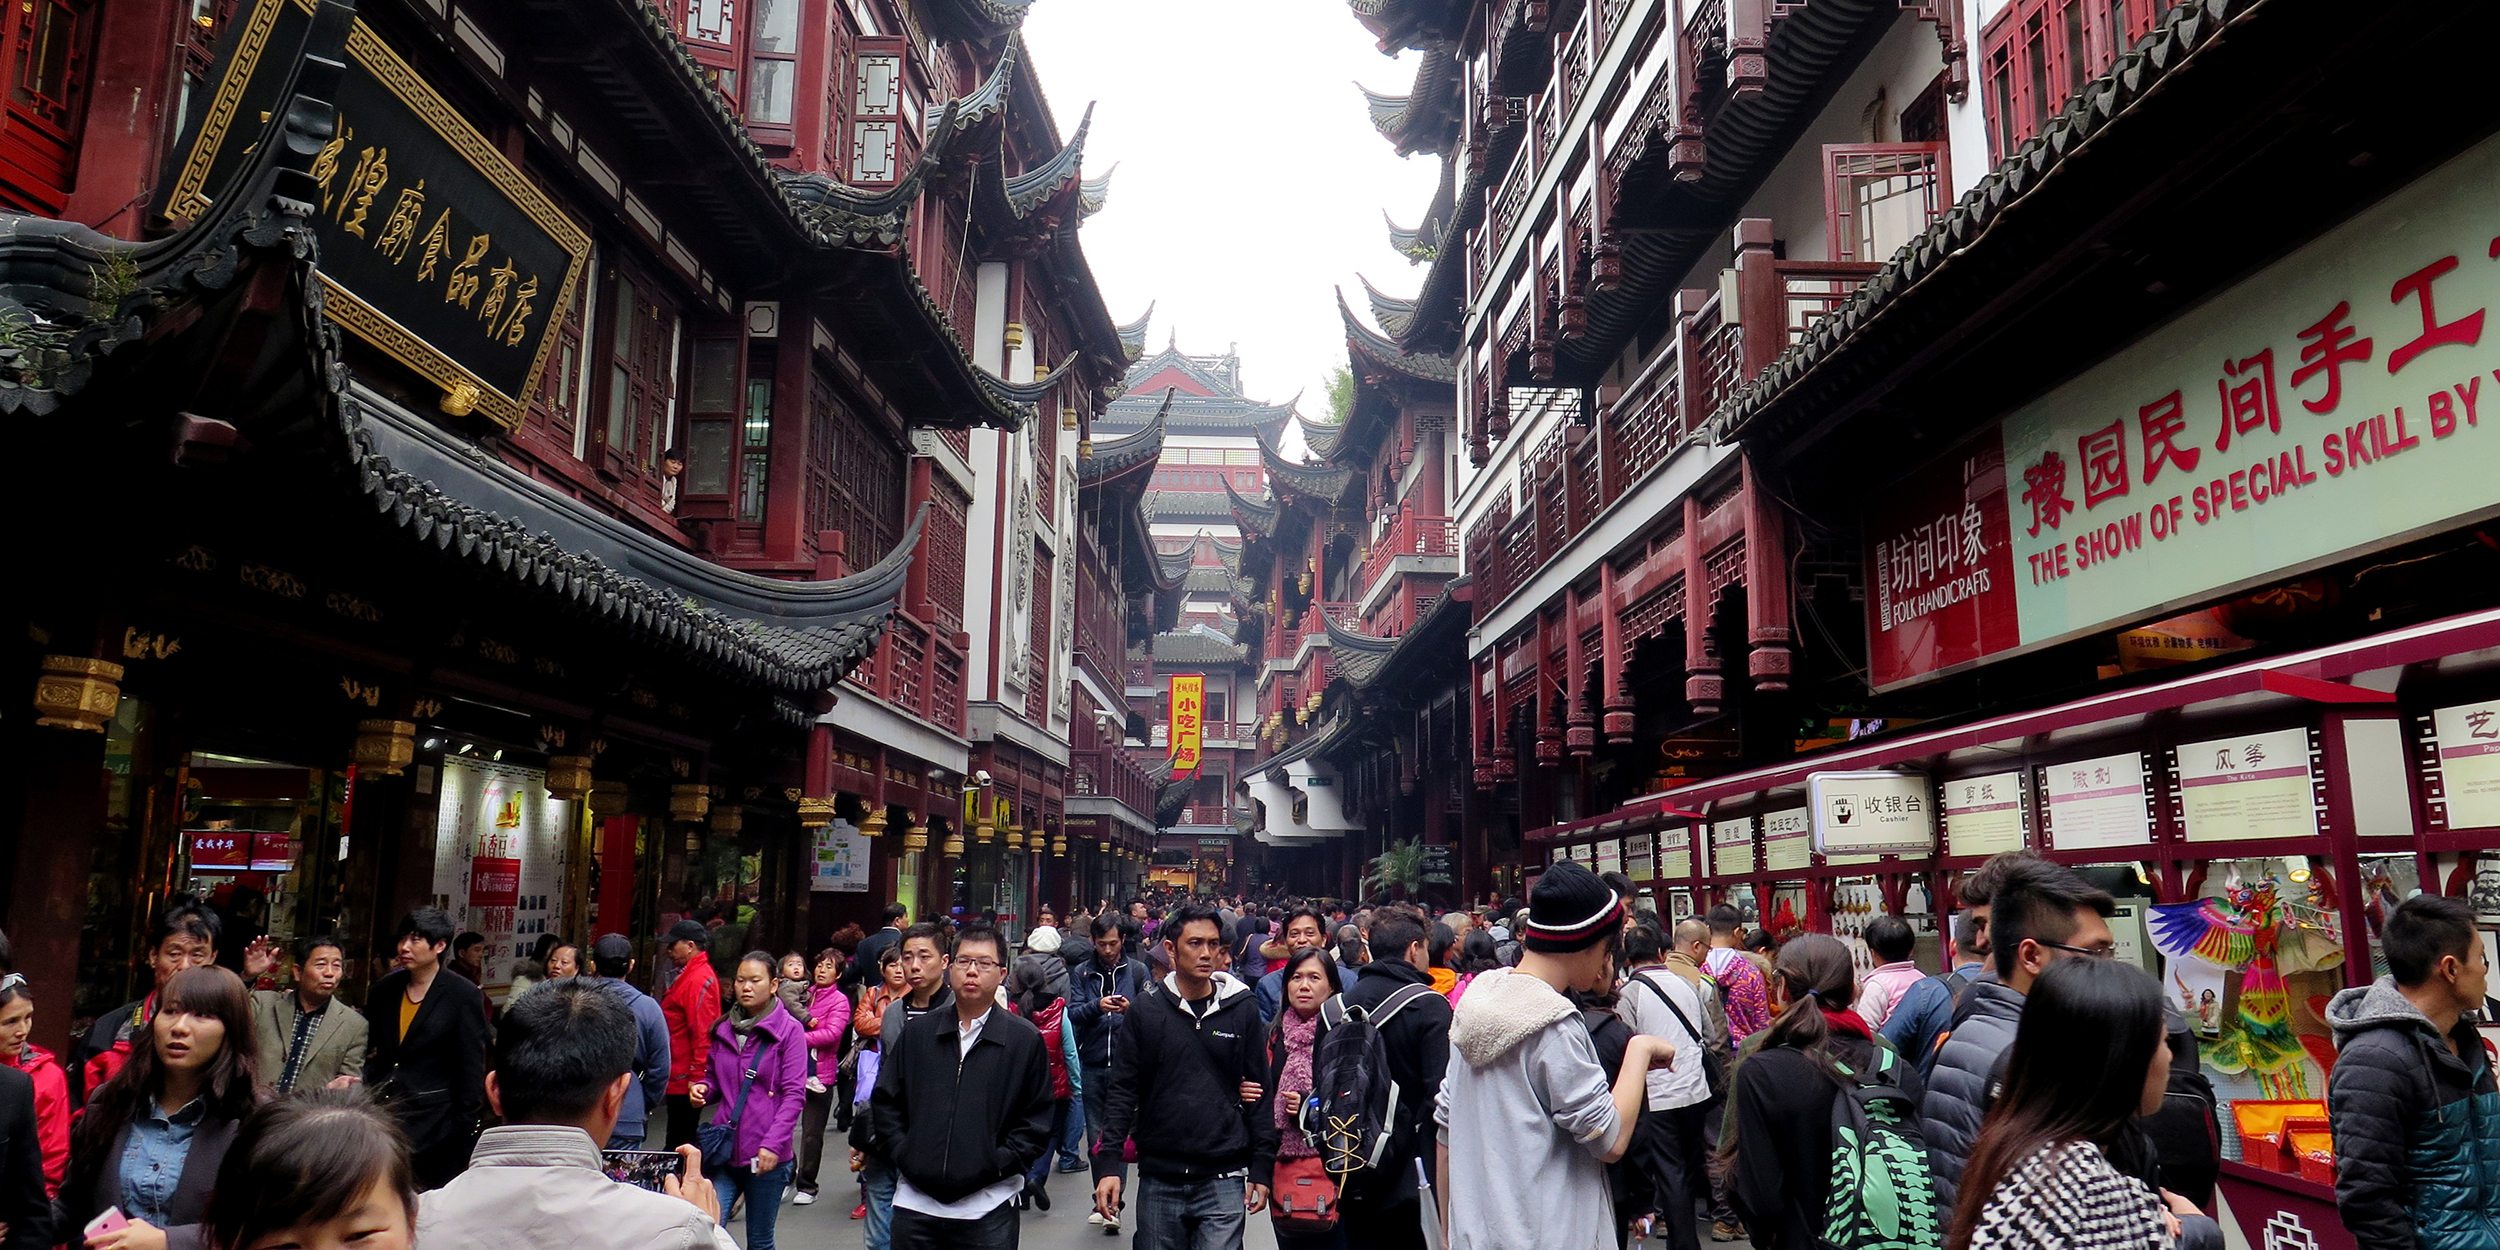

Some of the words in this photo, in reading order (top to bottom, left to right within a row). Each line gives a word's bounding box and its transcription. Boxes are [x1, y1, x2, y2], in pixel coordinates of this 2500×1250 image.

[2022, 236, 2500, 538] 豫园民间手工
[2028, 543, 2070, 586] THE
[2075, 512, 2142, 570] SHOW
[2150, 495, 2183, 541] OF
[2192, 445, 2317, 525] SPECIAL
[2323, 406, 2420, 476] SKILL
[2428, 376, 2481, 439] BY
[1890, 501, 1988, 594] 坊间印象
[1893, 596, 1919, 626] FOLK
[1920, 568, 1990, 615] HANDICRAFTS
[1177, 697, 1197, 762] 小吃广场
[2216, 743, 2266, 770] 风筝
[1864, 795, 1922, 814] 收银台
[1879, 815, 1909, 823] Cashier
